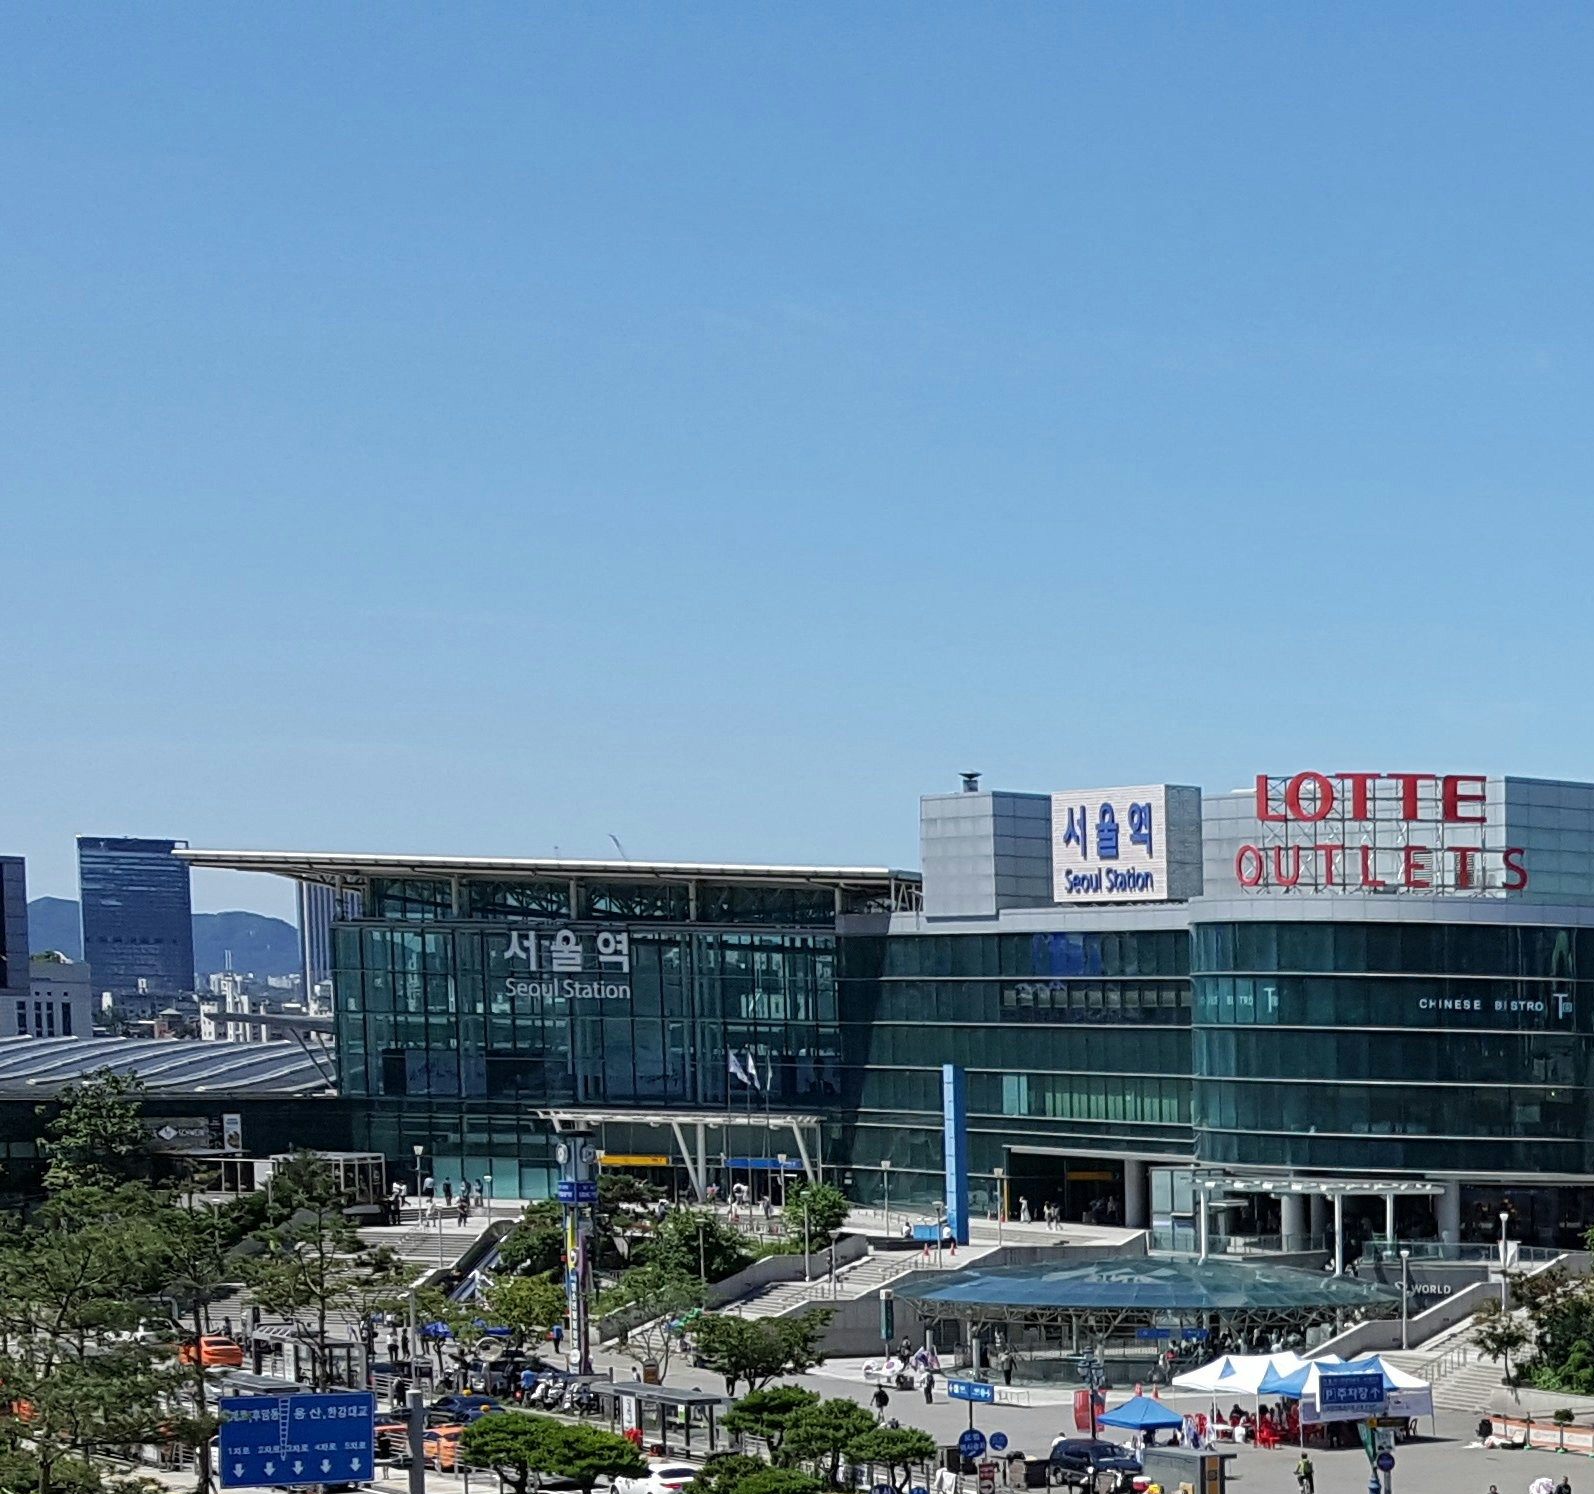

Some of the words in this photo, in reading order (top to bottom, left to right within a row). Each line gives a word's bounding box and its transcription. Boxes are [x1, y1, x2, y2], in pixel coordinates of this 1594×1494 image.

[1257, 772, 1487, 823] LOTTE
[1063, 802, 1153, 860] 서울역
[1065, 867, 1102, 894] Seoul
[1105, 866, 1154, 893] Station
[1235, 845, 1529, 890] OUTLETS
[503, 929, 630, 973] 서울역
[506, 978, 558, 998] Seoul
[563, 979, 631, 998] Station
[1419, 998, 1481, 1011] CHINESE
[1495, 1000, 1544, 1012] BISTRO
[1412, 1284, 1451, 1294] WORLD
